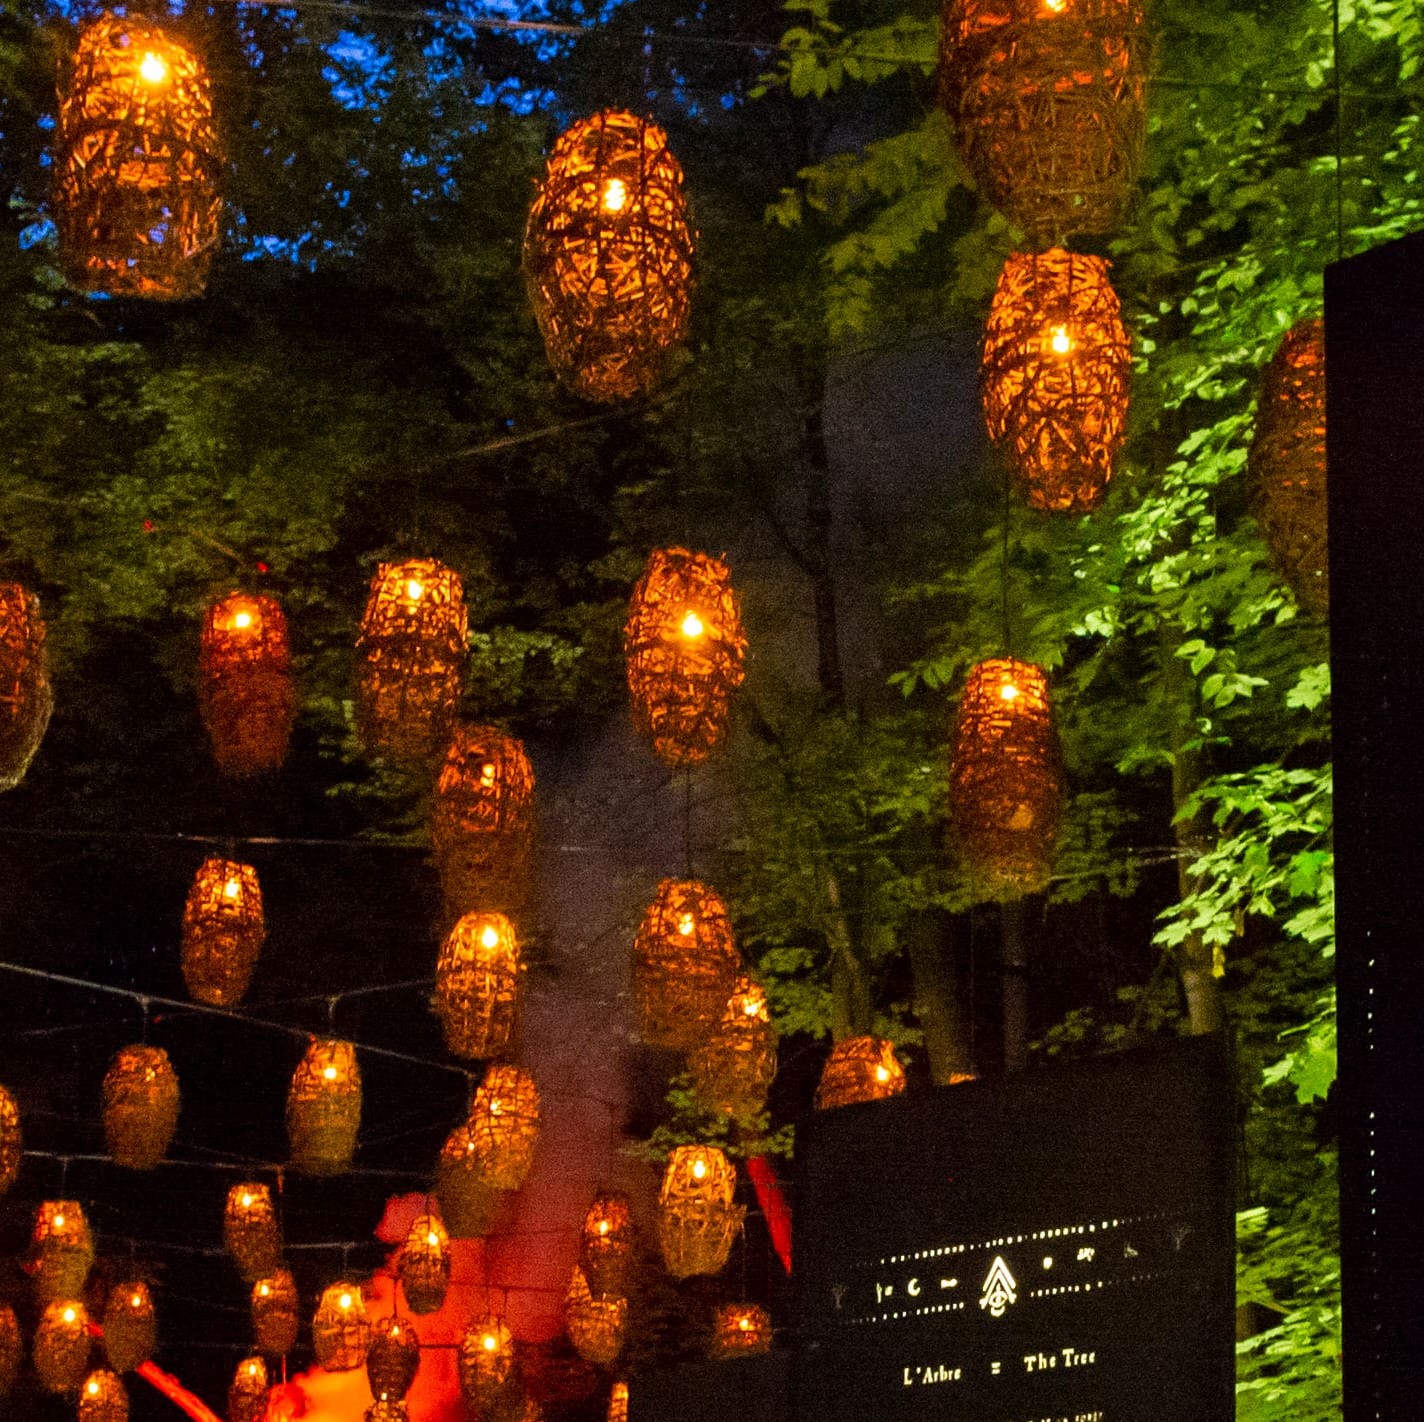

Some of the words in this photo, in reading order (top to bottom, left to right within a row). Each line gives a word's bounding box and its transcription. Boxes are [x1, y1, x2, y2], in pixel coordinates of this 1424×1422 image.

[904, 1365, 961, 1385] L'Arbre
[1024, 1353, 1056, 1371] The
[1062, 1348, 1095, 1367] Tree
